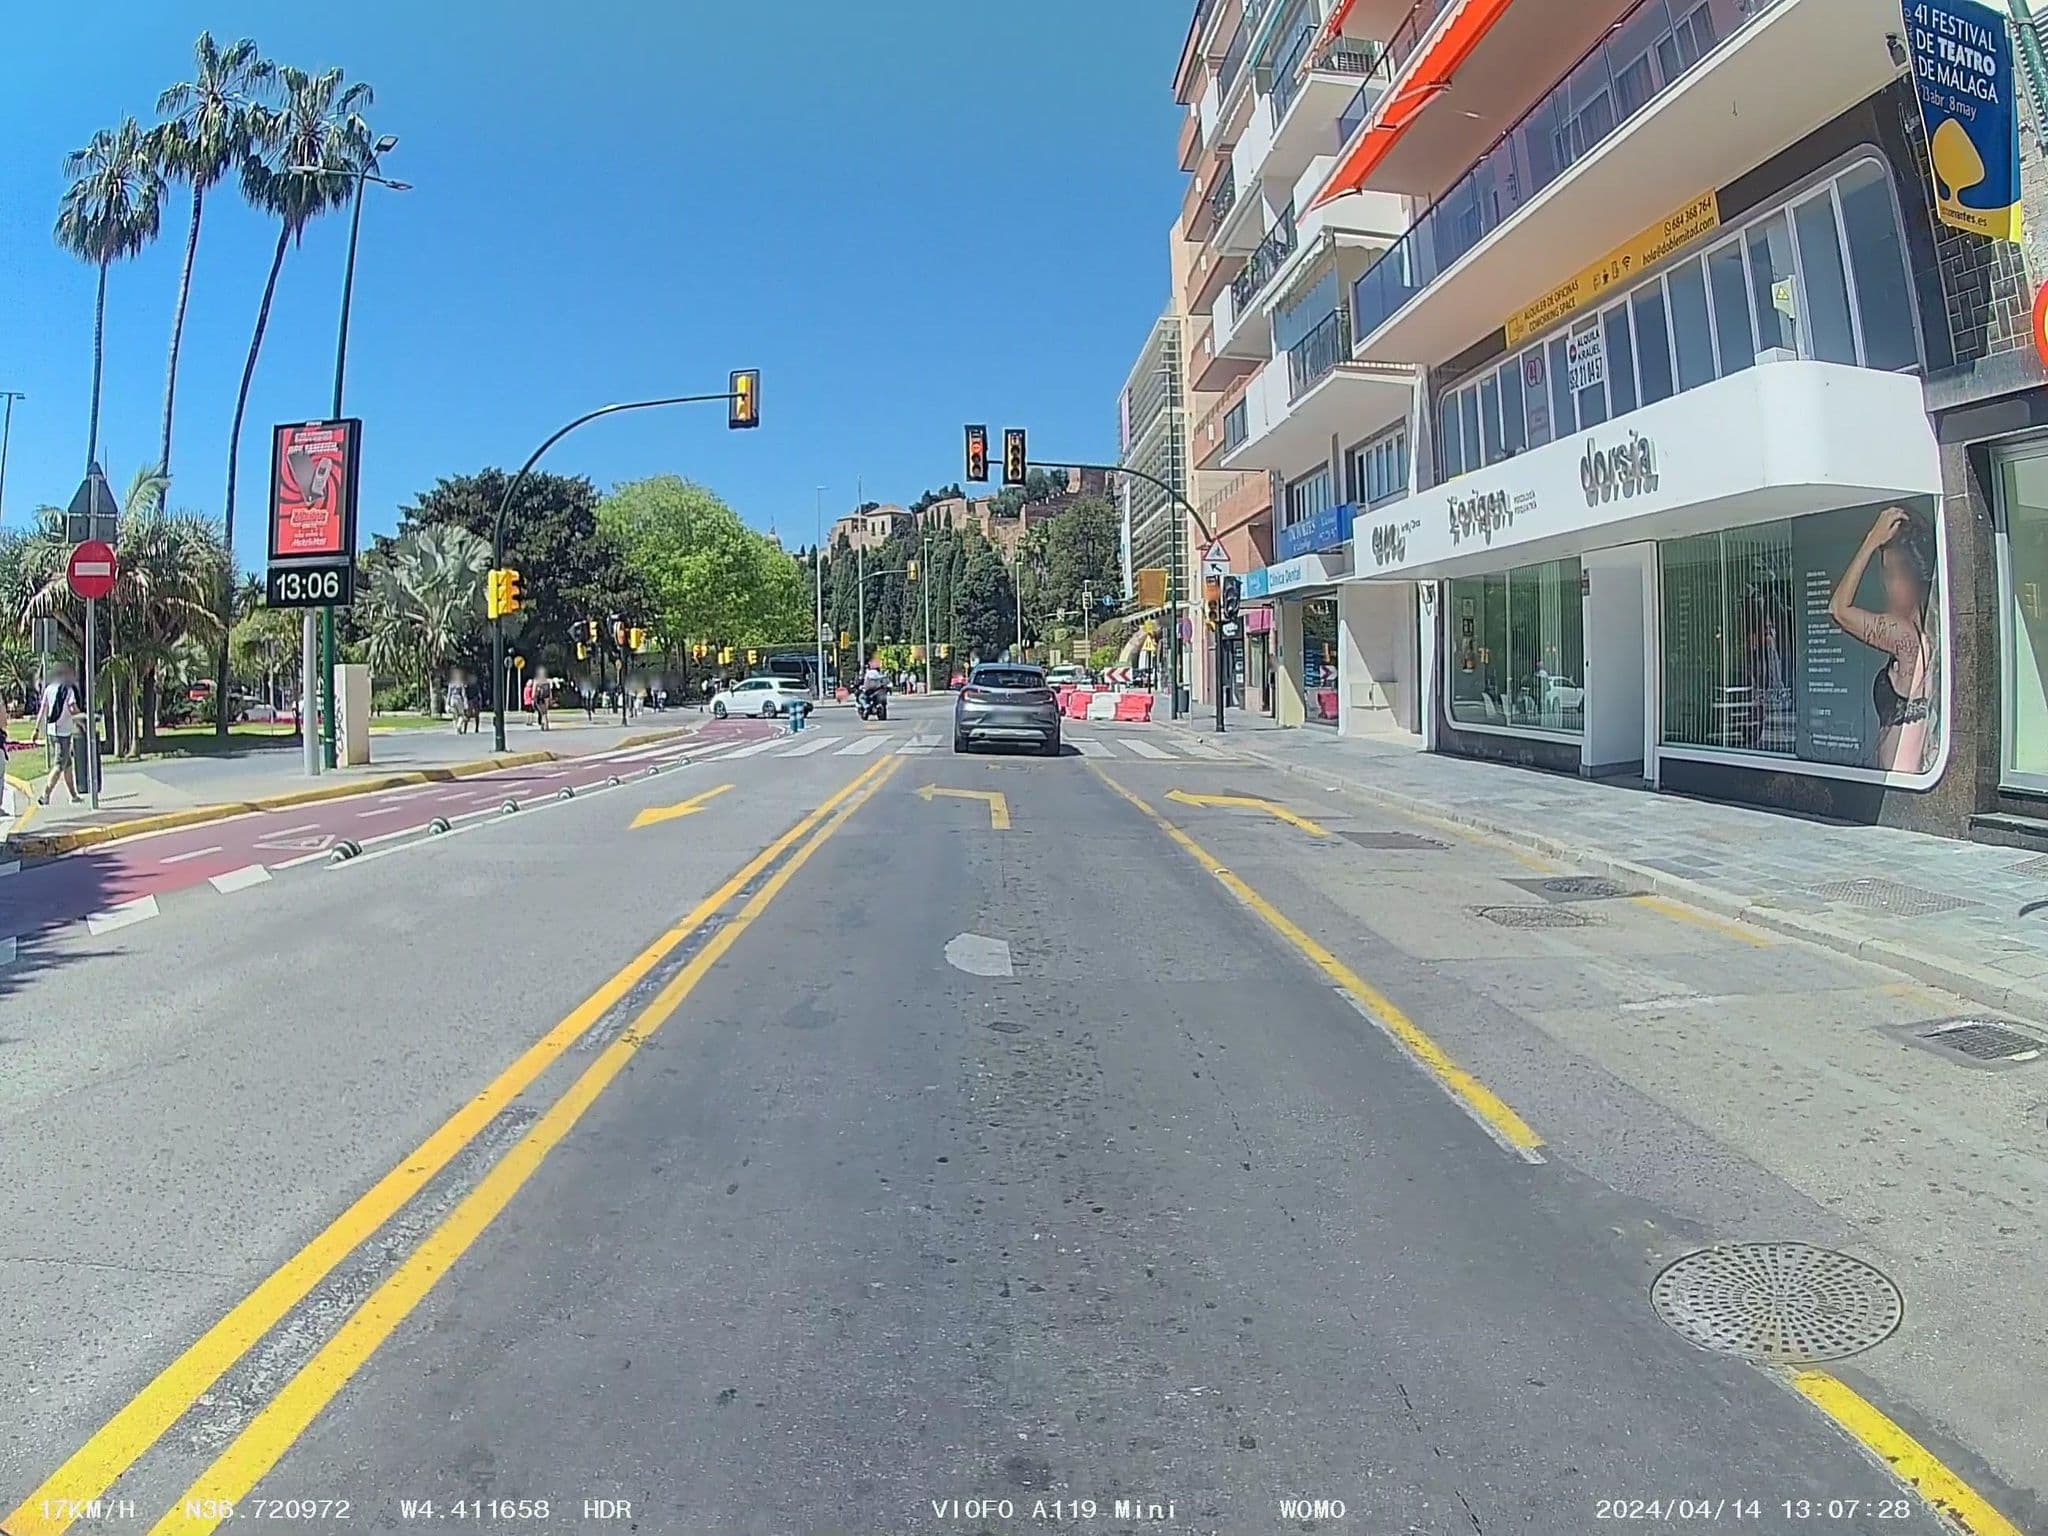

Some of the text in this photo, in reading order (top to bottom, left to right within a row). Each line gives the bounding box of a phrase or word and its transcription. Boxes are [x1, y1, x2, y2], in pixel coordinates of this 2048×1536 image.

[1914, 3, 1997, 53] 41 FESTIVAL
[1916, 28, 1996, 76] DE TEATRO
[1918, 55, 1999, 104] DE MÁLAGA
[1698, 196, 1712, 215] 764
[1580, 429, 1659, 507] dorsia
[276, 571, 339, 601] 13:06
